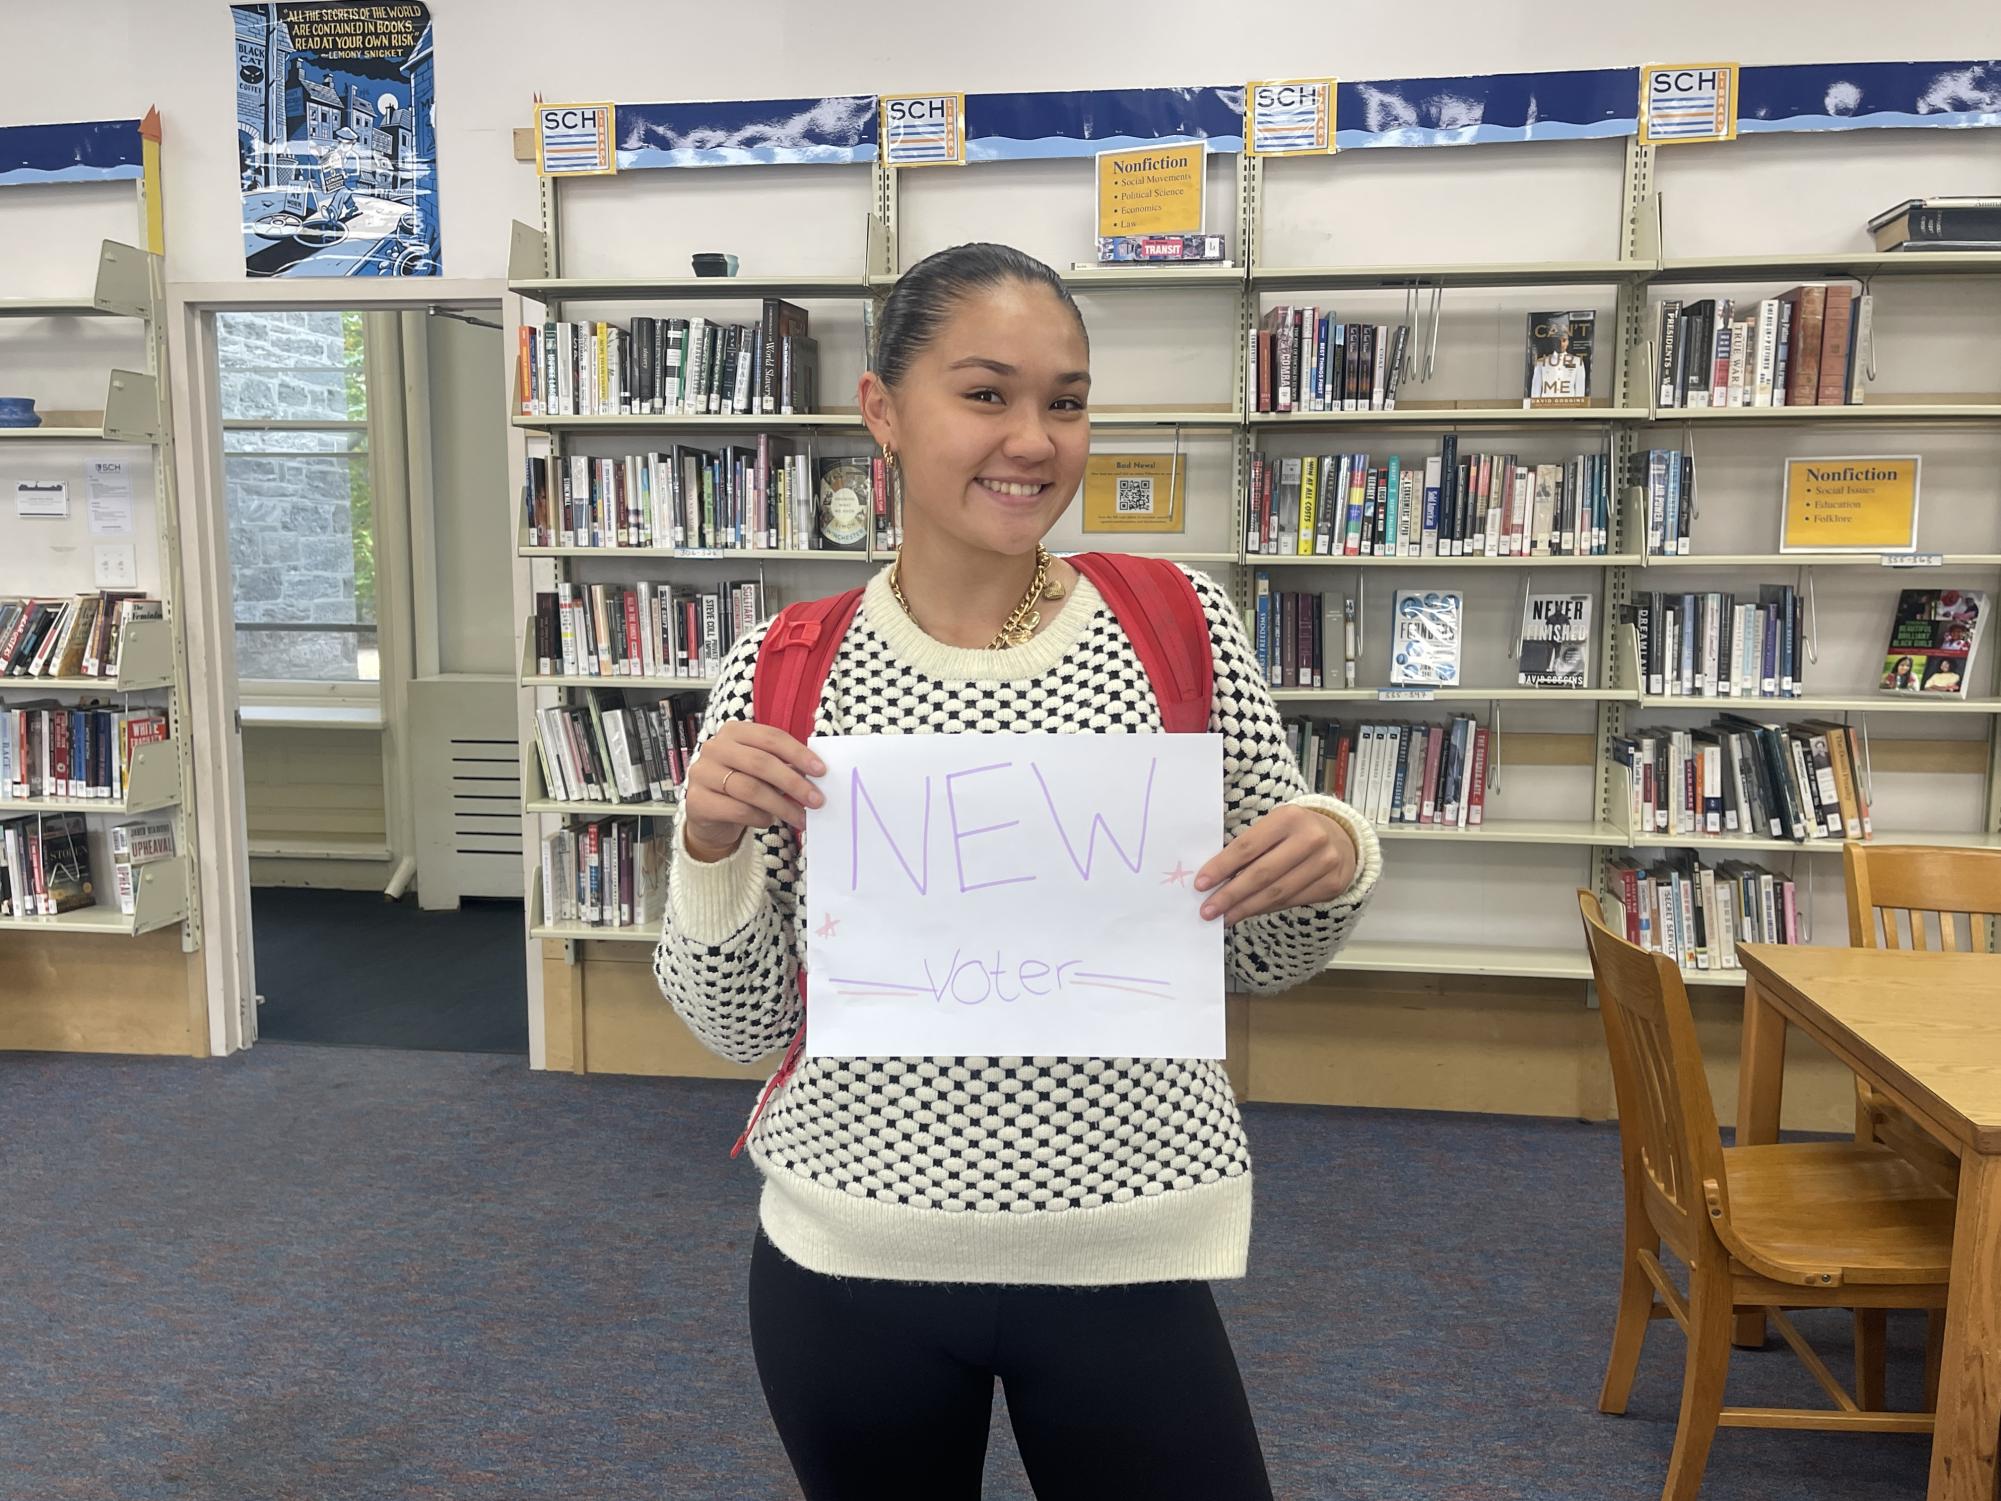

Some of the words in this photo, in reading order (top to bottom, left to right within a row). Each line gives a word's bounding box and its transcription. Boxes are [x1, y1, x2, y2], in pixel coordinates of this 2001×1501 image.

[305, 11, 321, 22] THE
[322, 8, 358, 21] SECRETS
[359, 8, 371, 19] OF
[372, 7, 388, 19] THE
[389, 5, 421, 18] WORLD
[293, 24, 311, 36] ARE
[312, 22, 362, 35] CONTAINED
[364, 22, 374, 33] IN
[239, 43, 264, 58] BLACK
[295, 37, 320, 51] READ
[321, 36, 333, 49] AT
[336, 36, 362, 49] YOUR
[365, 35, 388, 48] OWN
[239, 55, 262, 65] CAT
[364, 49, 403, 58] SNICKET
[1654, 71, 1716, 93] SCH
[1257, 87, 1316, 108] SCH
[1716, 72, 1726, 132] LIBRARY
[890, 100, 945, 121] SCH
[545, 110, 597, 130] SCH
[946, 98, 955, 157] LIBRARY
[1113, 155, 1188, 174] Nonfiction
[1121, 177, 1145, 187] Social
[1147, 173, 1192, 184] Movements
[1121, 189, 1152, 201] Political
[1154, 187, 1184, 197] Science
[1121, 205, 1162, 215] Economics
[1120, 220, 1137, 229] Law
[1145, 244, 1182, 255] TRANSIT
[1534, 322, 1591, 339] CAN'T
[1664, 313, 1676, 368] PRESIDENTS
[1733, 325, 1743, 356] TRUE
[765, 342, 775, 366] World
[1731, 359, 1741, 383] WAR
[763, 368, 774, 397] Slavery
[1543, 380, 1571, 394] ME
[102, 463, 120, 473] SCH
[1805, 467, 1898, 482] Nonfiction
[1428, 490, 1438, 503] Sold
[1655, 483, 1666, 496] AIR
[1816, 486, 1844, 495] Social
[1304, 501, 1312, 522] COSTS
[1654, 497, 1665, 522] POWER
[1815, 500, 1861, 509] Education
[1426, 502, 1436, 526] American
[1814, 514, 1852, 523] Folklore
[706, 600, 714, 620] STEVE
[742, 586, 753, 624] SOLITARY
[1532, 600, 1584, 621] NEVER
[630, 623, 638, 640] FAMILY
[707, 621, 715, 638] COLL
[1259, 612, 1267, 651] FREEDOMS
[1523, 624, 1587, 642] FINISHED
[1640, 610, 1649, 676] DREAMLAN
[132, 720, 160, 738] WHITE
[1477, 735, 1486, 748] THE
[131, 828, 147, 838] JARED
[148, 824, 170, 835] DIAMOND
[851, 756, 1158, 896] NEW
[130, 838, 173, 858] UPHEAVAL
[117, 865, 131, 897] UPHEAV
[1664, 892, 1673, 921] SECRET
[1667, 923, 1676, 956] SERVICE
